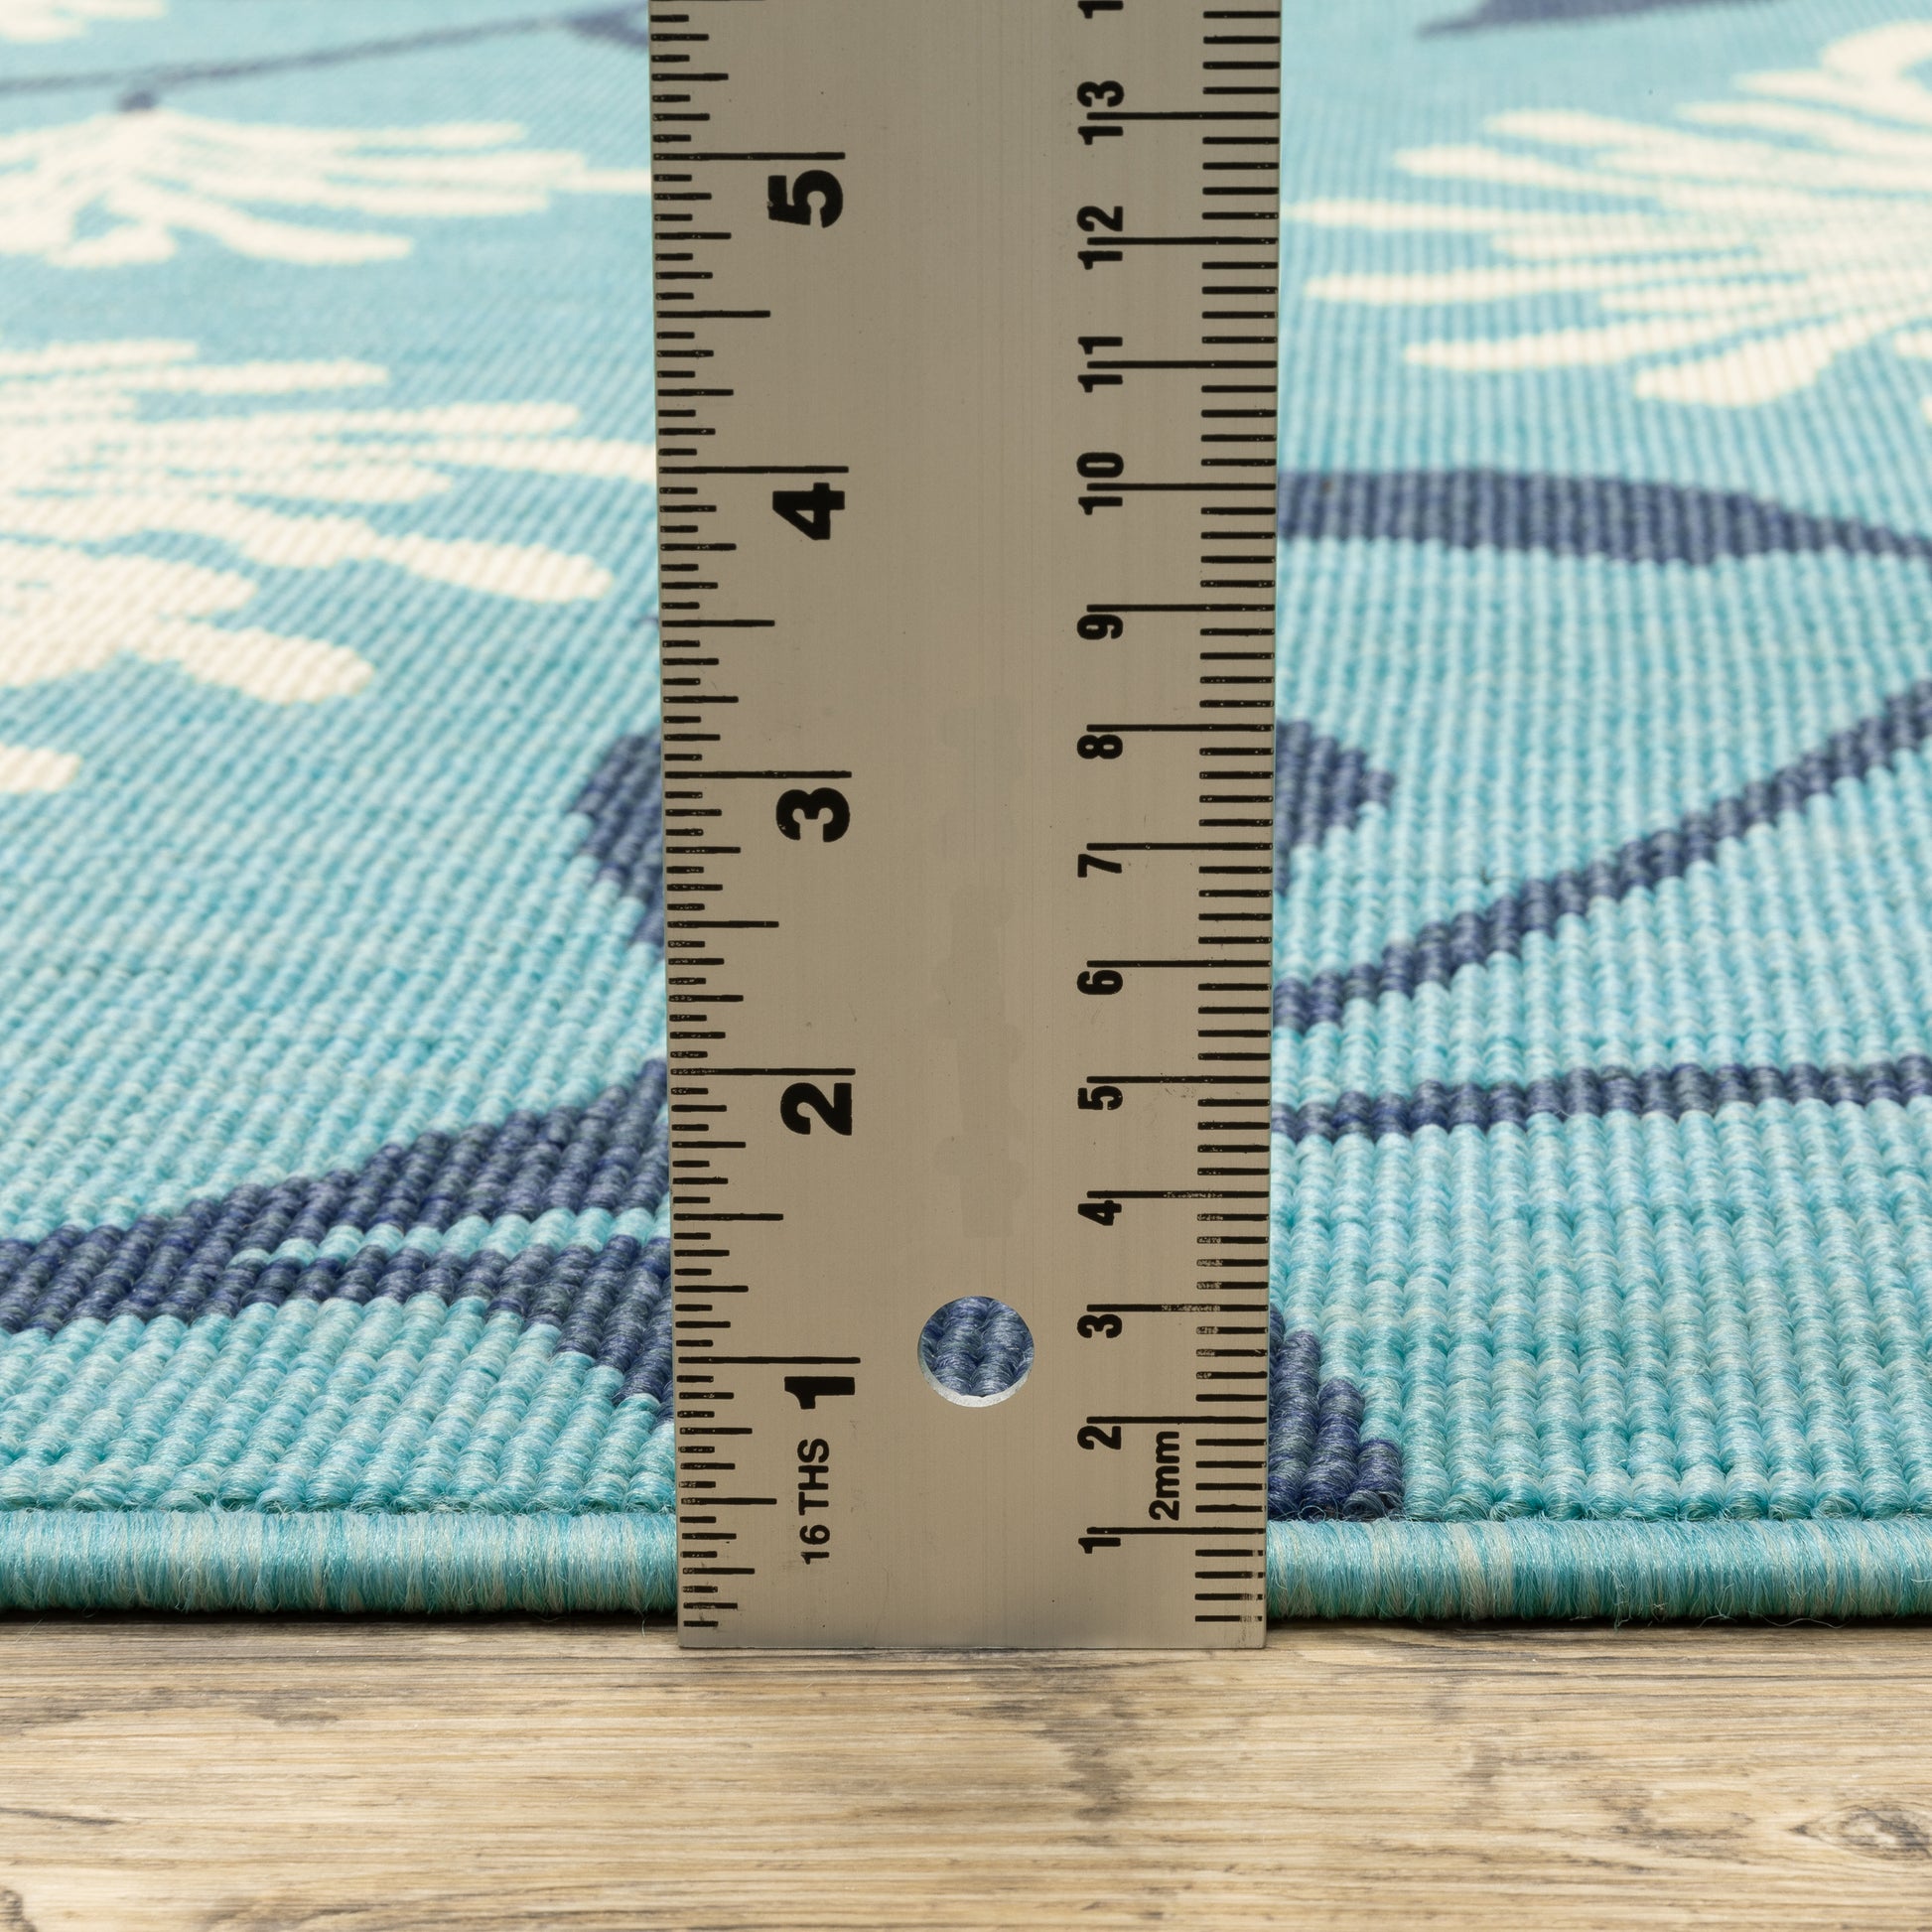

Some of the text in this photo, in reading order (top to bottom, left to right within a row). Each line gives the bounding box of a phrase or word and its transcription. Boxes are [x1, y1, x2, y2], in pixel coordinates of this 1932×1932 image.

[1077, 79, 1124, 146] 13
[766, 169, 845, 229] 5
[1077, 206, 1124, 271] 12
[1077, 336, 1124, 393] 11
[1076, 452, 1124, 516] 10
[771, 482, 846, 541] 4
[1076, 614, 1124, 640] 9
[1076, 734, 1124, 760] 8
[775, 786, 851, 843] 3
[1077, 853, 1123, 879] 7
[1076, 969, 1124, 996] 6
[779, 1082, 853, 1137] 2
[1077, 1085, 1124, 1111] 5
[1077, 1199, 1123, 1227] 4
[1076, 1313, 1123, 1339] 3
[783, 1375, 856, 1411] 1
[1076, 1425, 1122, 1450] 2
[1148, 1431, 1180, 1522] 2mm
[796, 1438, 831, 1566] 16 THS
[1077, 1536, 1122, 1555] 1
